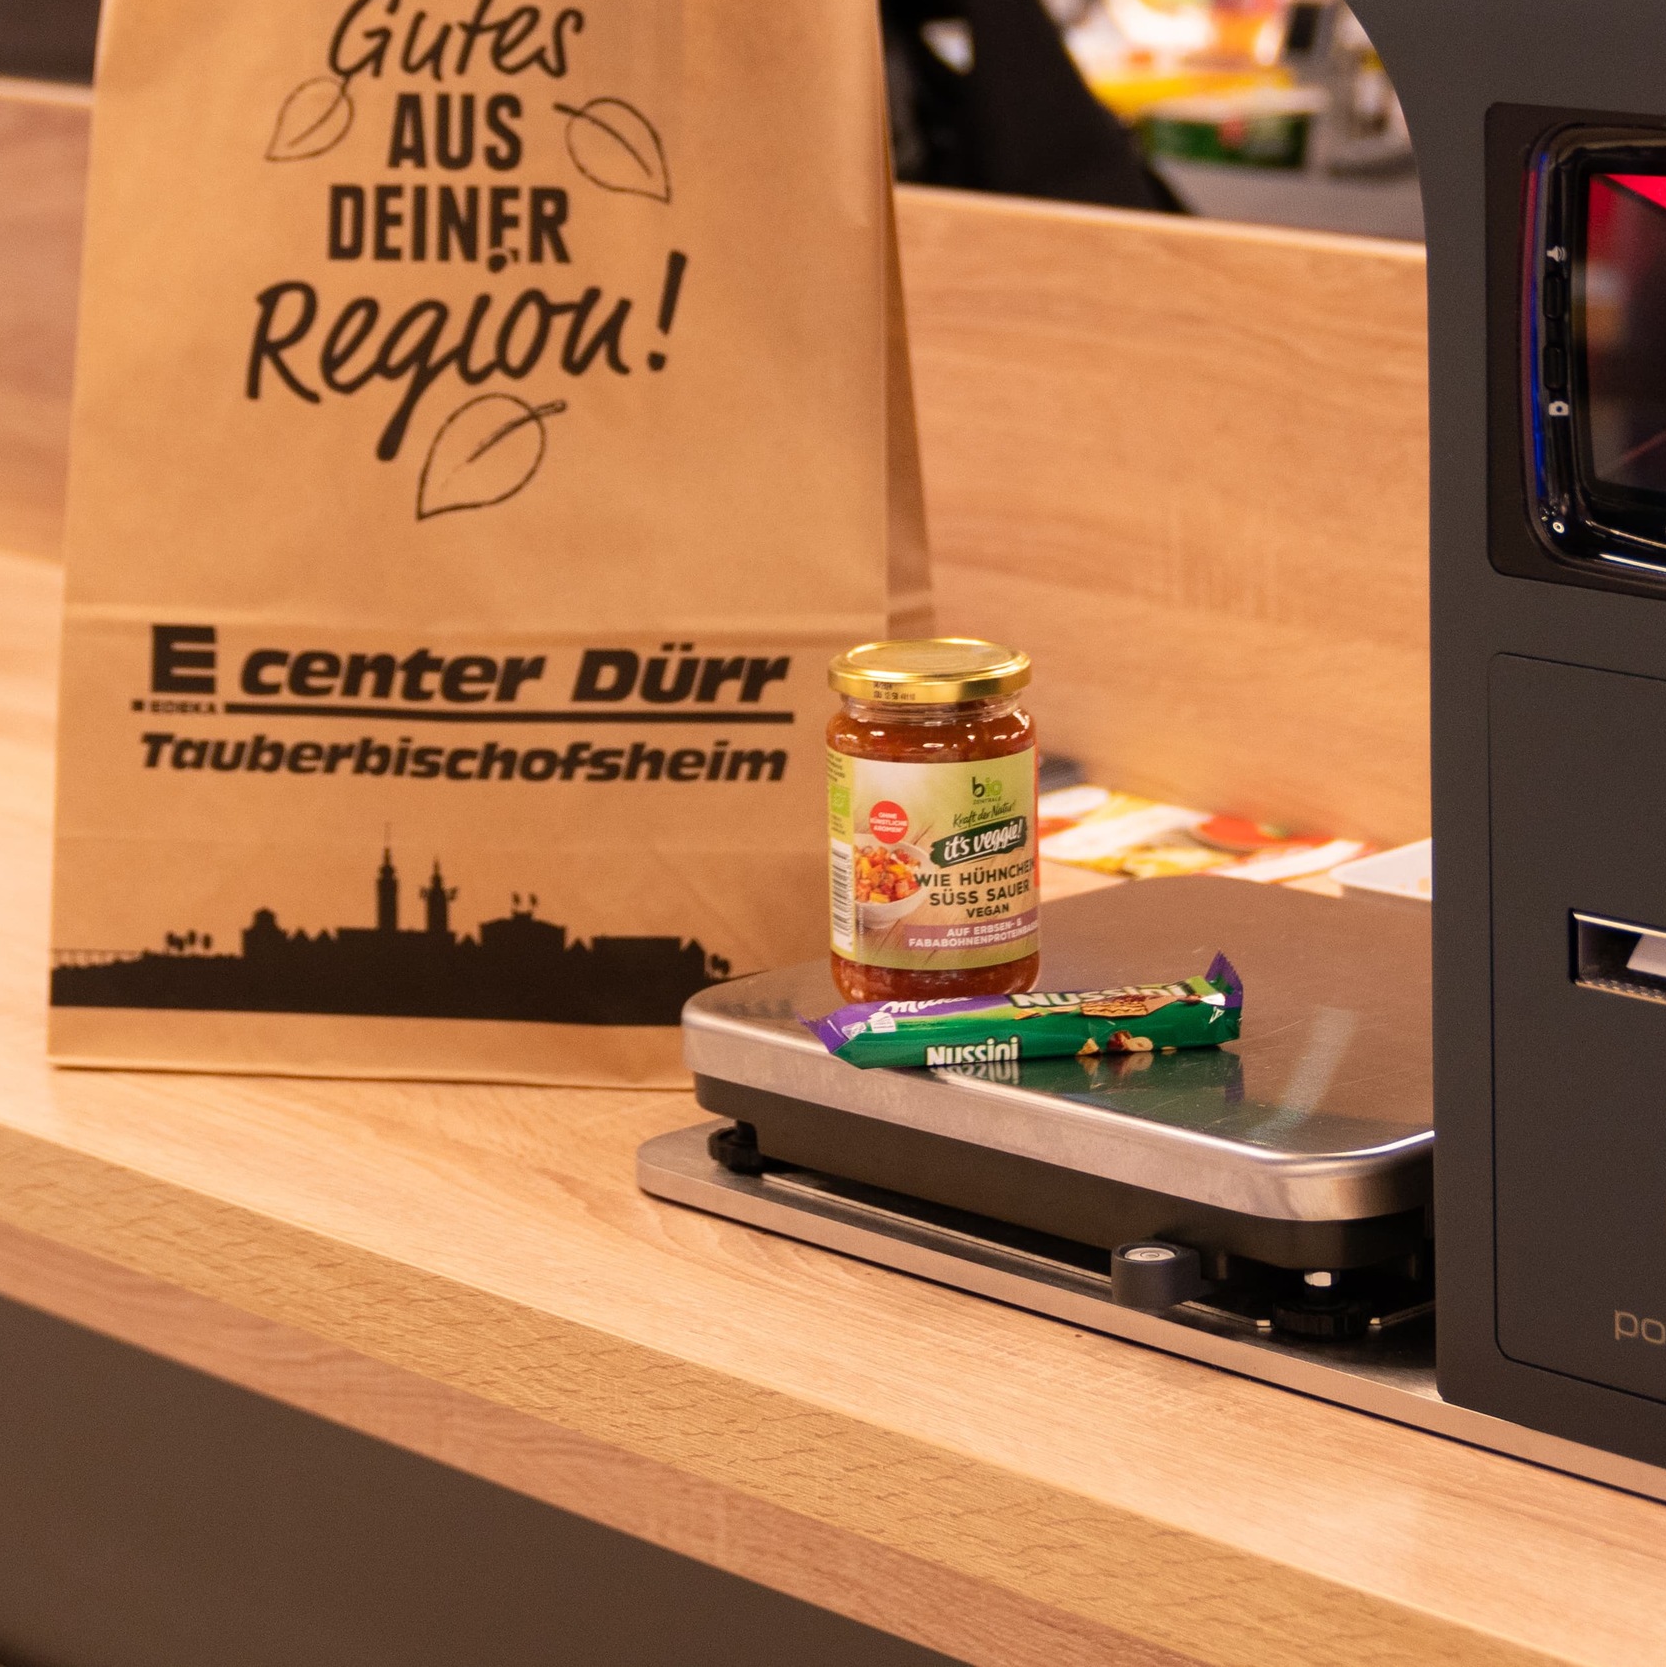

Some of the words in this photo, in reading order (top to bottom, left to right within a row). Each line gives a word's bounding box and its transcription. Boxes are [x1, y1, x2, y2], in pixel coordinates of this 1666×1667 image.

[388, 92, 524, 171] AUS
[326, 183, 572, 265] DEINER
[246, 249, 688, 462] Region!
[152, 624, 216, 694] E
[240, 646, 546, 705] center
[571, 644, 792, 705] Dürr
[140, 732, 790, 782] Tauberbischofsheim
[972, 776, 1002, 798] bio
[973, 818, 1024, 852] veggie!
[915, 874, 951, 887] WIE
[930, 889, 979, 906] SÜSS
[986, 879, 1029, 902] SAUER
[966, 903, 1009, 918] VEGAN
[947, 928, 970, 937] AUF
[926, 1036, 1019, 1066] Nussini
